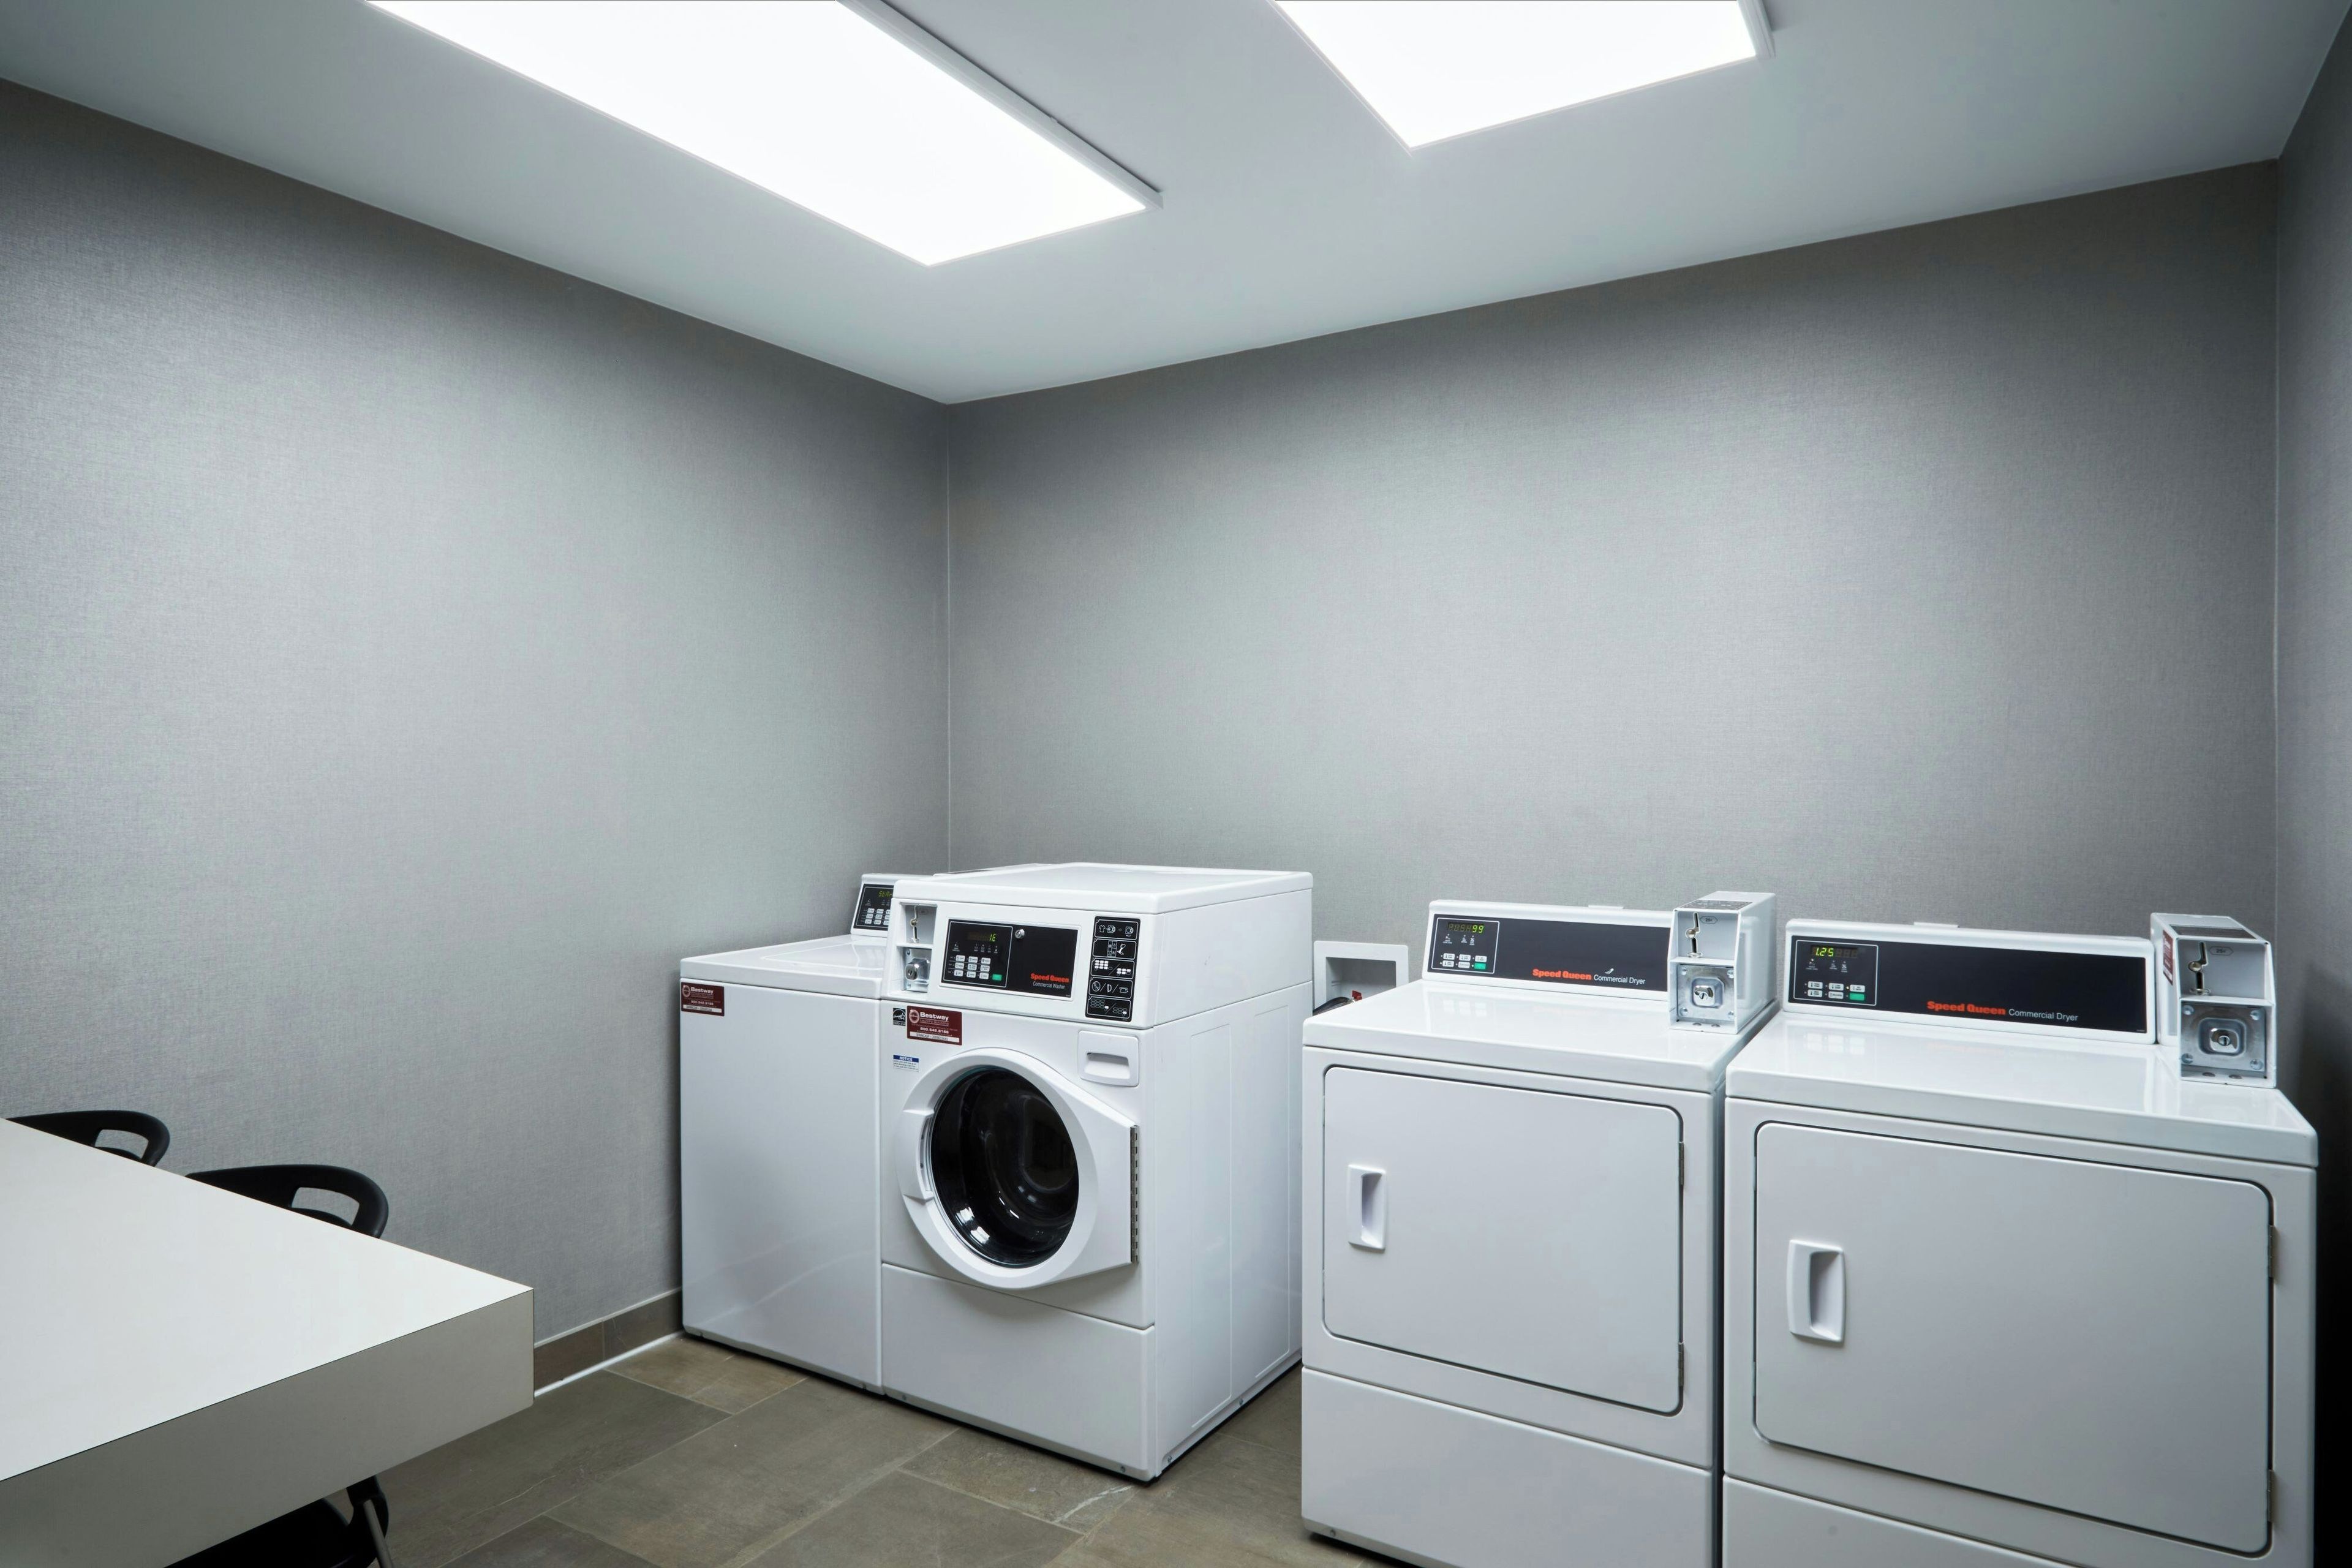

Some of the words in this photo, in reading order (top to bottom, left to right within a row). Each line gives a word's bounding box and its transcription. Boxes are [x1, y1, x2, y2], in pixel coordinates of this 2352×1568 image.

[1030, 973, 1049, 981] Speed
[1050, 974, 1069, 983] Queen
[1532, 968, 1561, 978] Speed
[1562, 971, 1592, 981] Queen
[1594, 974, 1628, 983] Commercial
[1629, 977, 1646, 986] Dryer
[920, 1012, 949, 1021] Bestway
[1927, 1001, 1965, 1012] Speed
[1966, 1003, 2006, 1015] Queen
[2008, 1008, 2054, 1019] Commercial
[2056, 1012, 2078, 1022] Dryer
